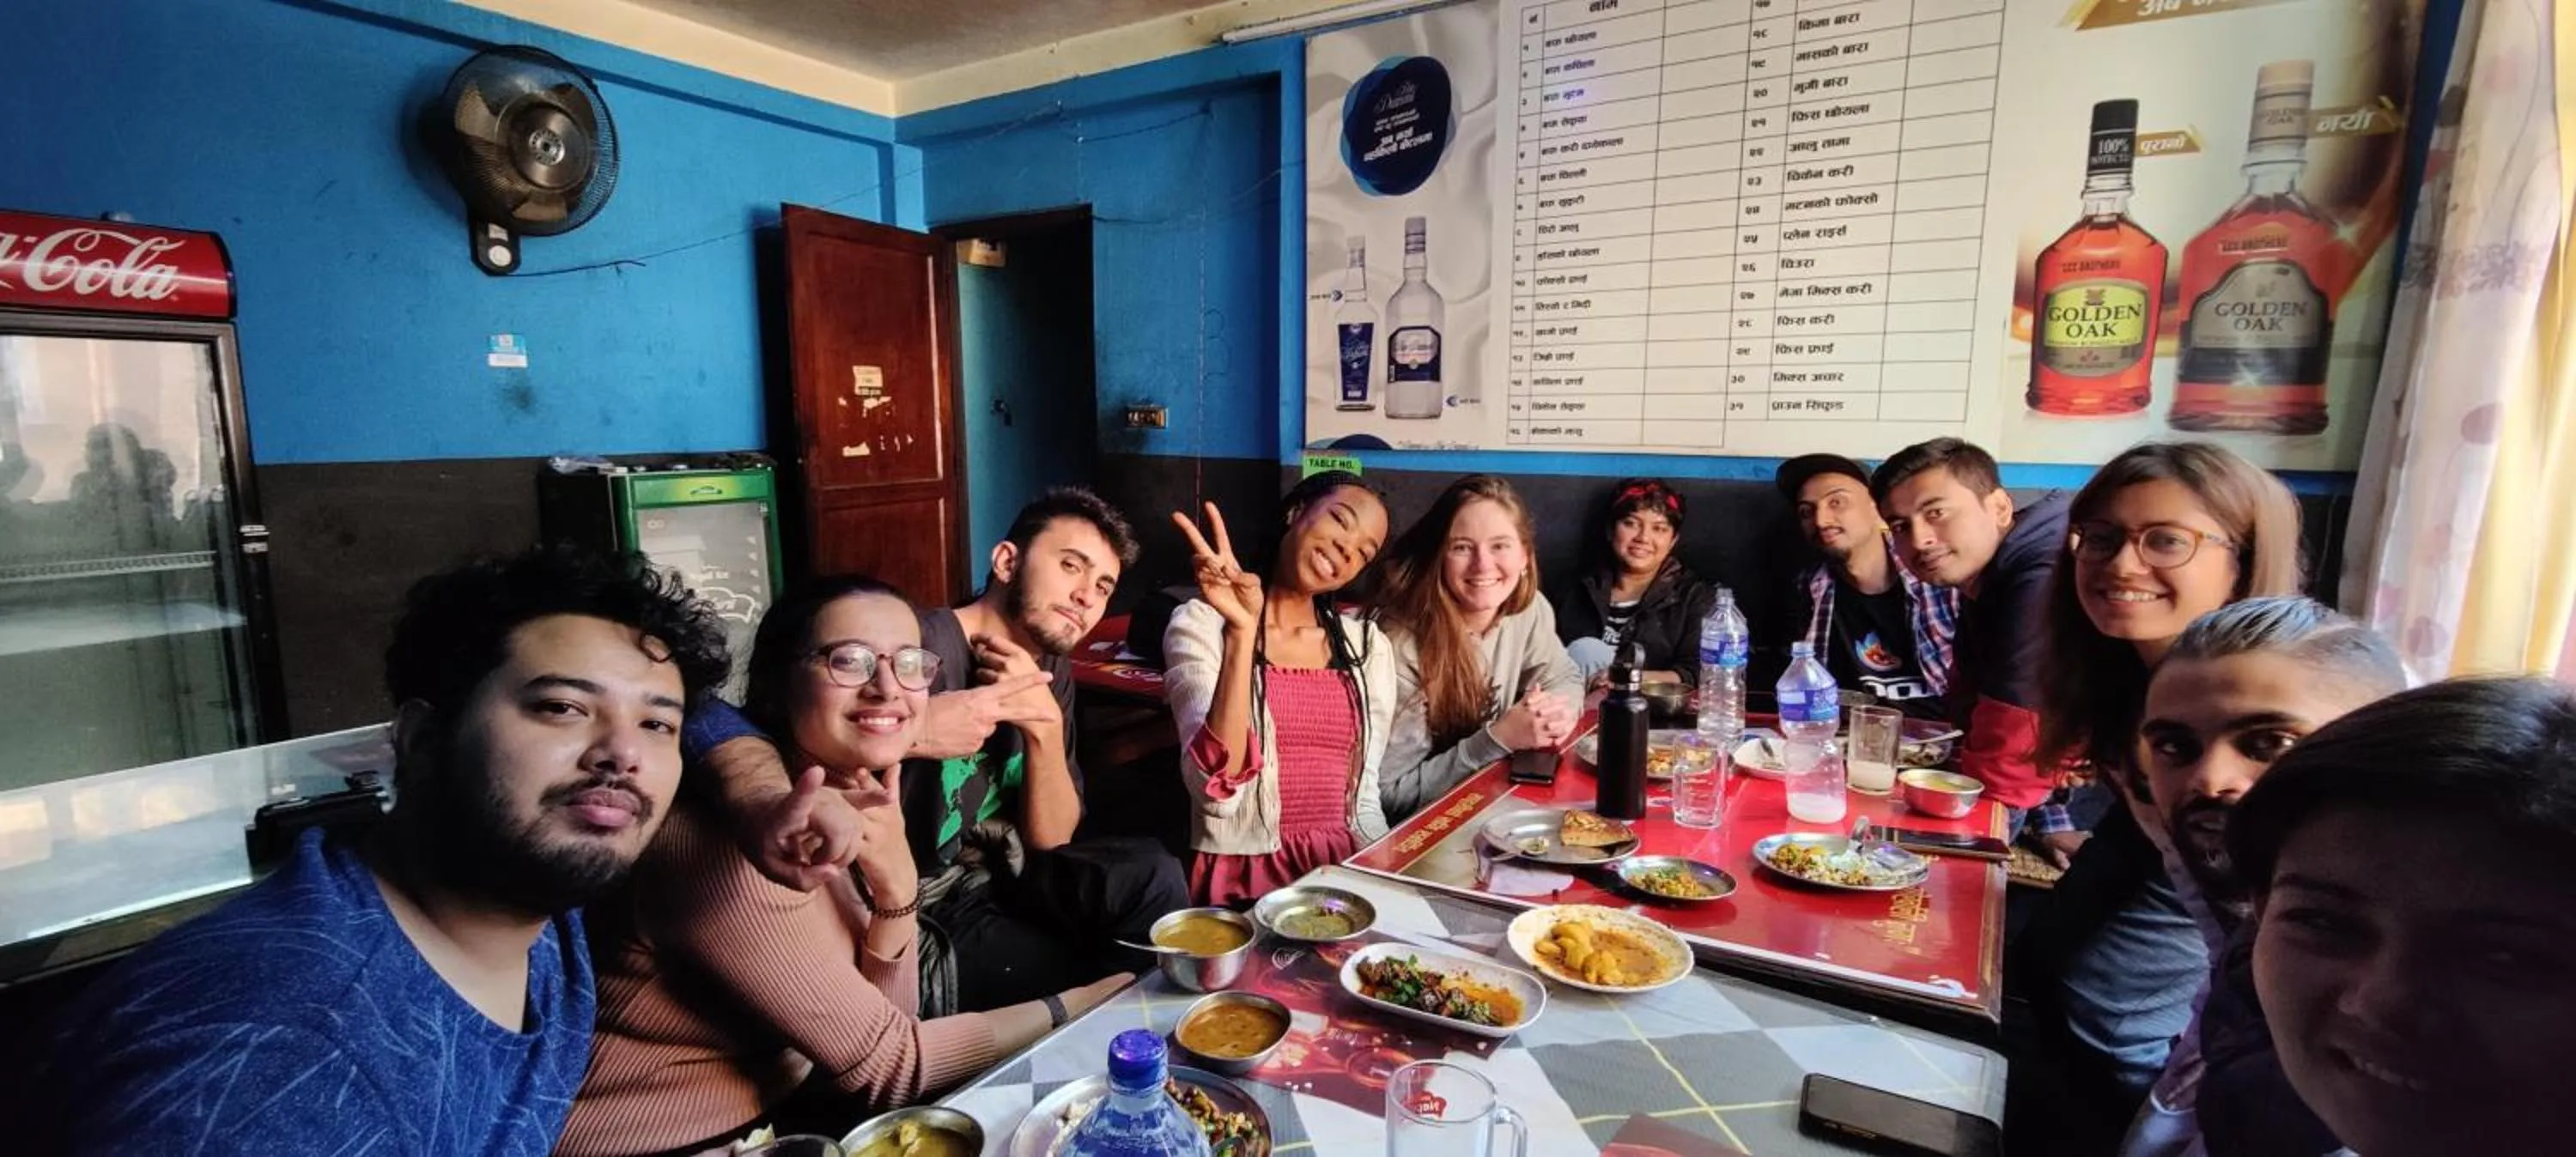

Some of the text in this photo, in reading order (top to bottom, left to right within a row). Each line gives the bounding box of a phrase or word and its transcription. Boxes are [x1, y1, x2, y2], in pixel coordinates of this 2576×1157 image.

[2098, 137, 2130, 153] 100%
[2047, 302, 2142, 322] GOLDEN
[2215, 301, 2309, 317] GOLDEN
[2065, 322, 2117, 338] OAK
[2234, 317, 2285, 330] OAK
[1309, 457, 1354, 469] TABLE NO.
